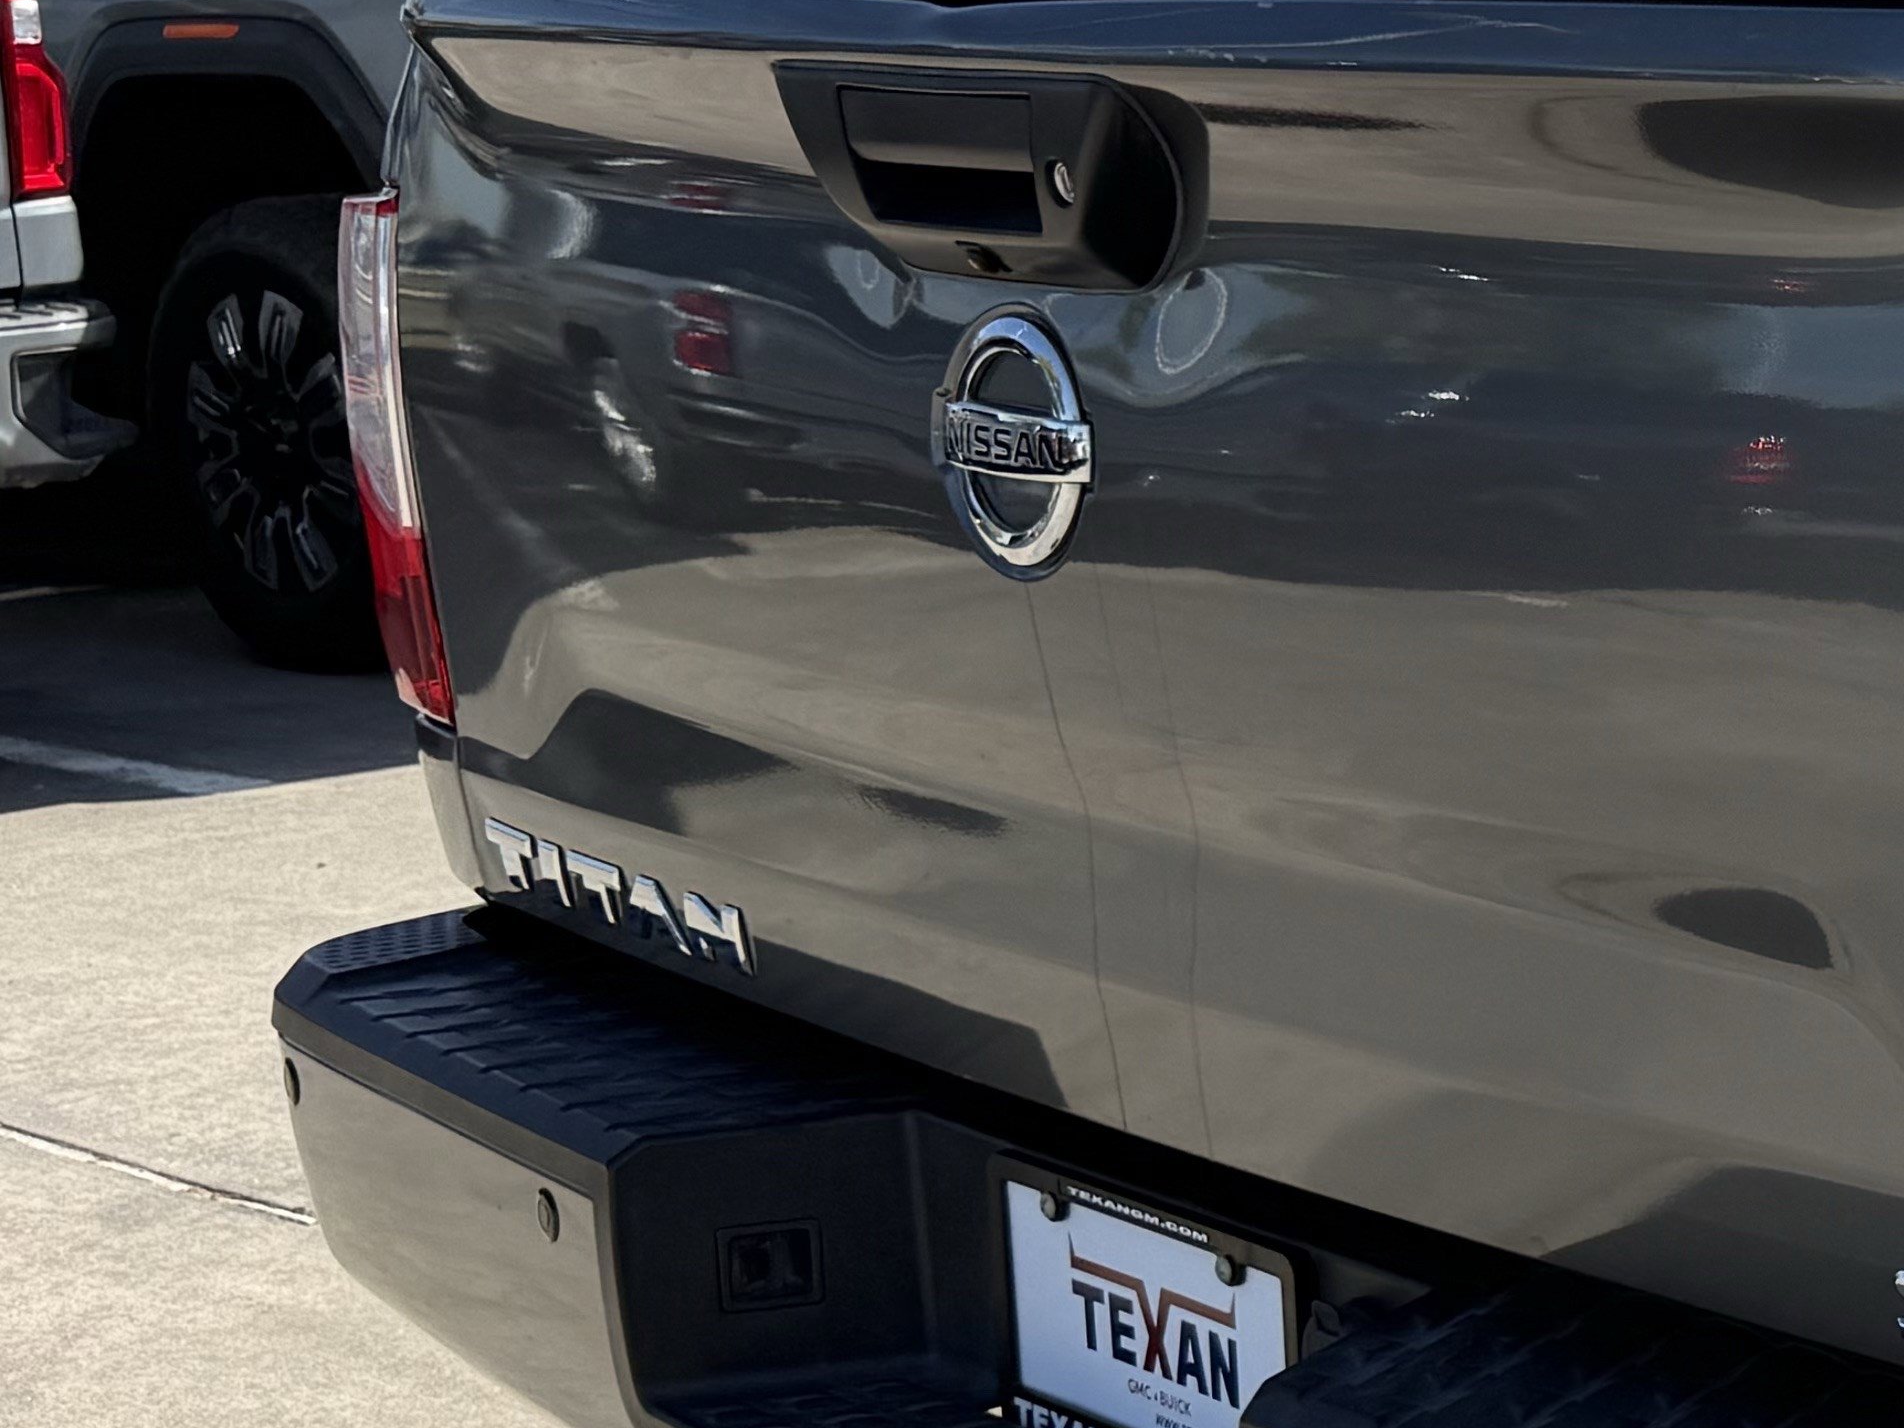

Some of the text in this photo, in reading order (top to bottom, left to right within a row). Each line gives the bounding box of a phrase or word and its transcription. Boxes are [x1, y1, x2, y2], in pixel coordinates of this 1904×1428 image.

[947, 418, 1064, 470] NISSAN
[484, 815, 757, 977] TITAN
[1066, 1184, 1209, 1244] TEXANGM.COM
[1068, 1231, 1240, 1410] TEXAN
